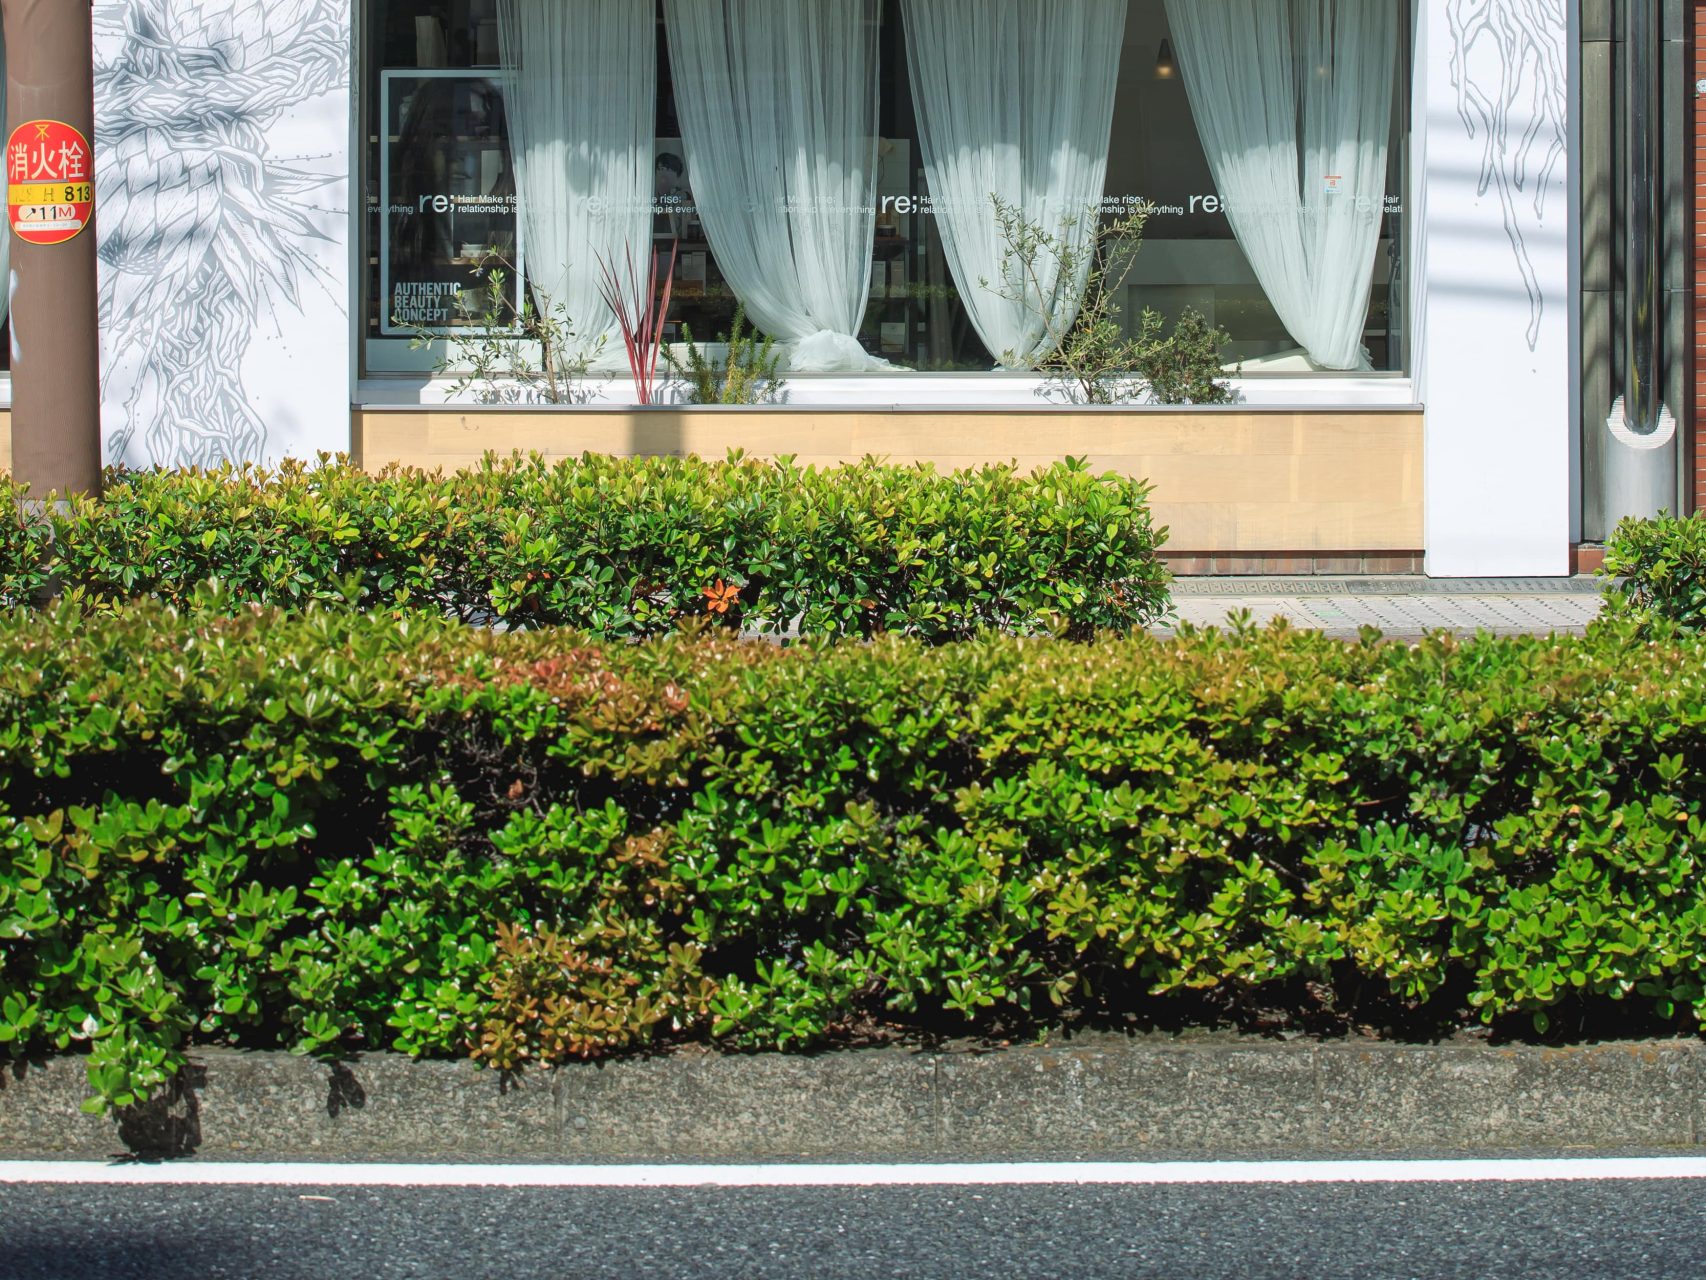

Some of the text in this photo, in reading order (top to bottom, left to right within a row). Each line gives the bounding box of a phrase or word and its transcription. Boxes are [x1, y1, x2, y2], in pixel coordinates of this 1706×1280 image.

[10, 141, 84, 180] 消火栓
[64, 186, 91, 202] 813
[419, 194, 455, 213] re;
[458, 195, 477, 204] Hair
[479, 195, 503, 204] Make
[458, 204, 509, 215] relationship
[665, 205, 673, 213] is
[881, 195, 918, 214] re;
[1189, 195, 1225, 213] re;
[394, 282, 461, 296] AUTHENTIC
[394, 295, 440, 309] BEAUTY
[394, 308, 449, 321] CONCEPT
